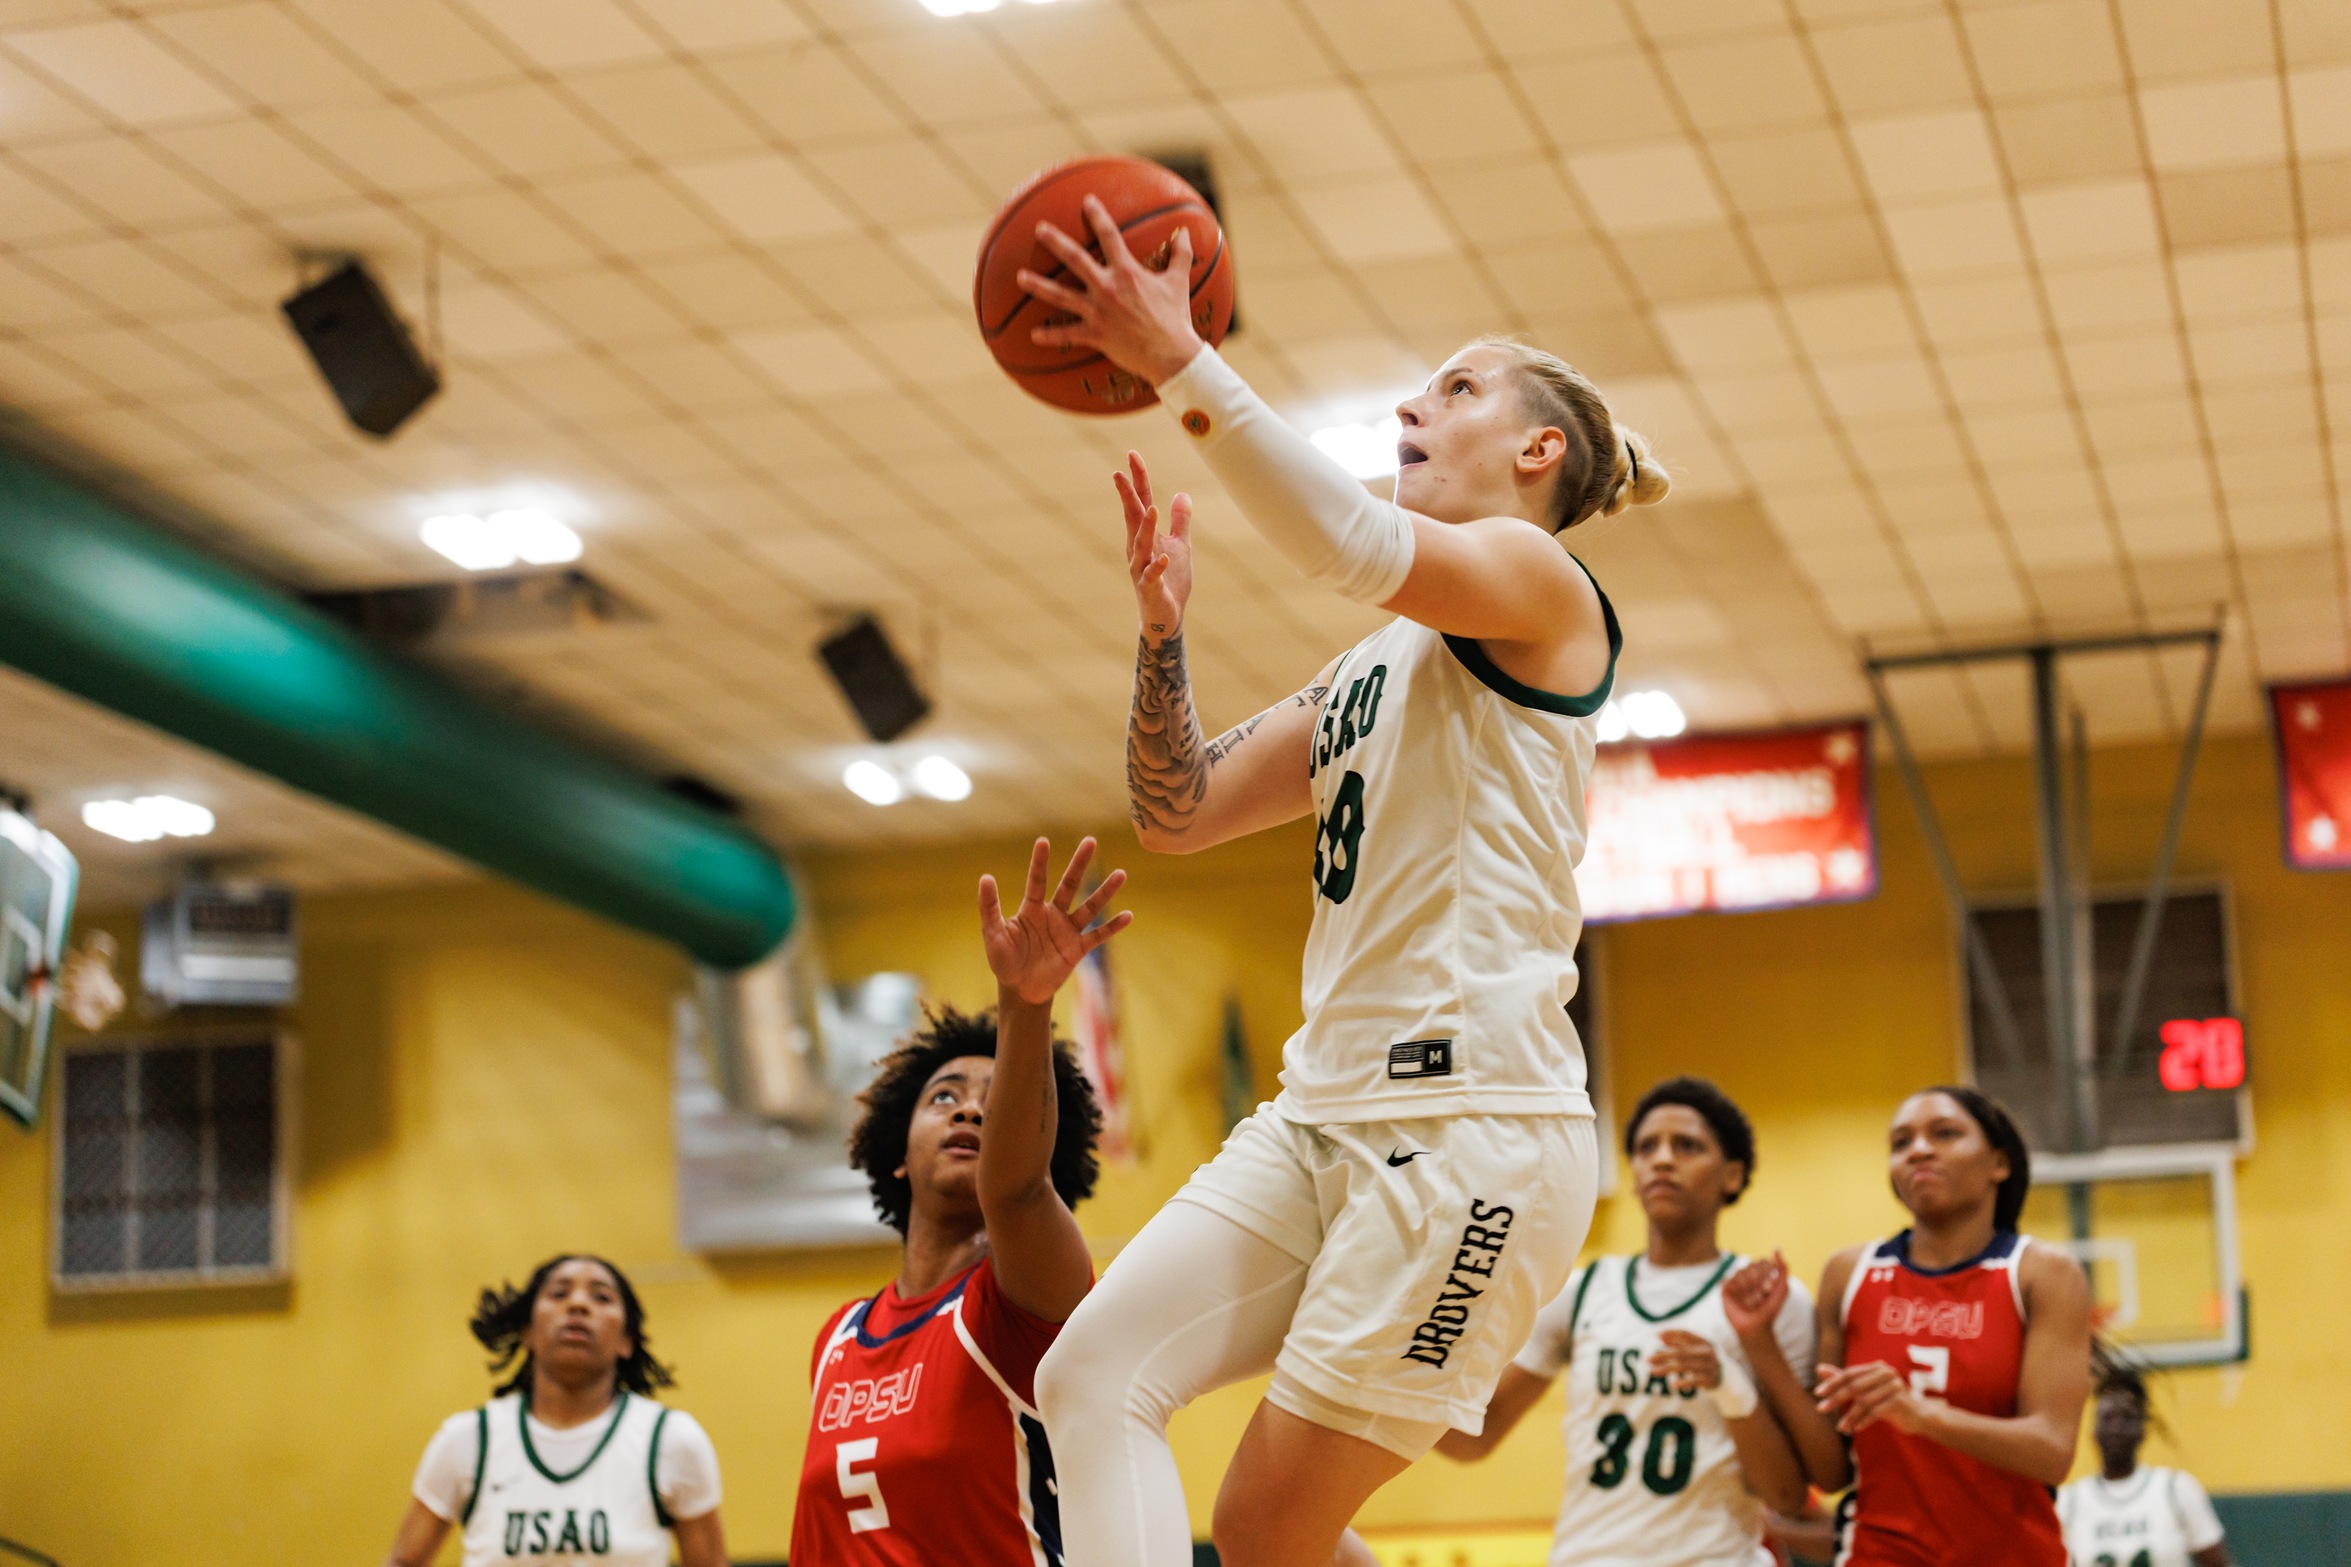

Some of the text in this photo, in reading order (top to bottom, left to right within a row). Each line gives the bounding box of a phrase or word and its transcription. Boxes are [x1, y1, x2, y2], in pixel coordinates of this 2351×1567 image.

[1429, 1050, 1443, 1065] M
[2159, 1017, 2245, 1092] 20
[1400, 1198, 1514, 1370] DROVERS
[1879, 1296, 1984, 1340] OPSU
[818, 1362, 924, 1433] OPSU
[836, 1437, 890, 1534] 5
[1589, 1412, 1696, 1496] 30
[503, 1510, 611, 1556] USAO
